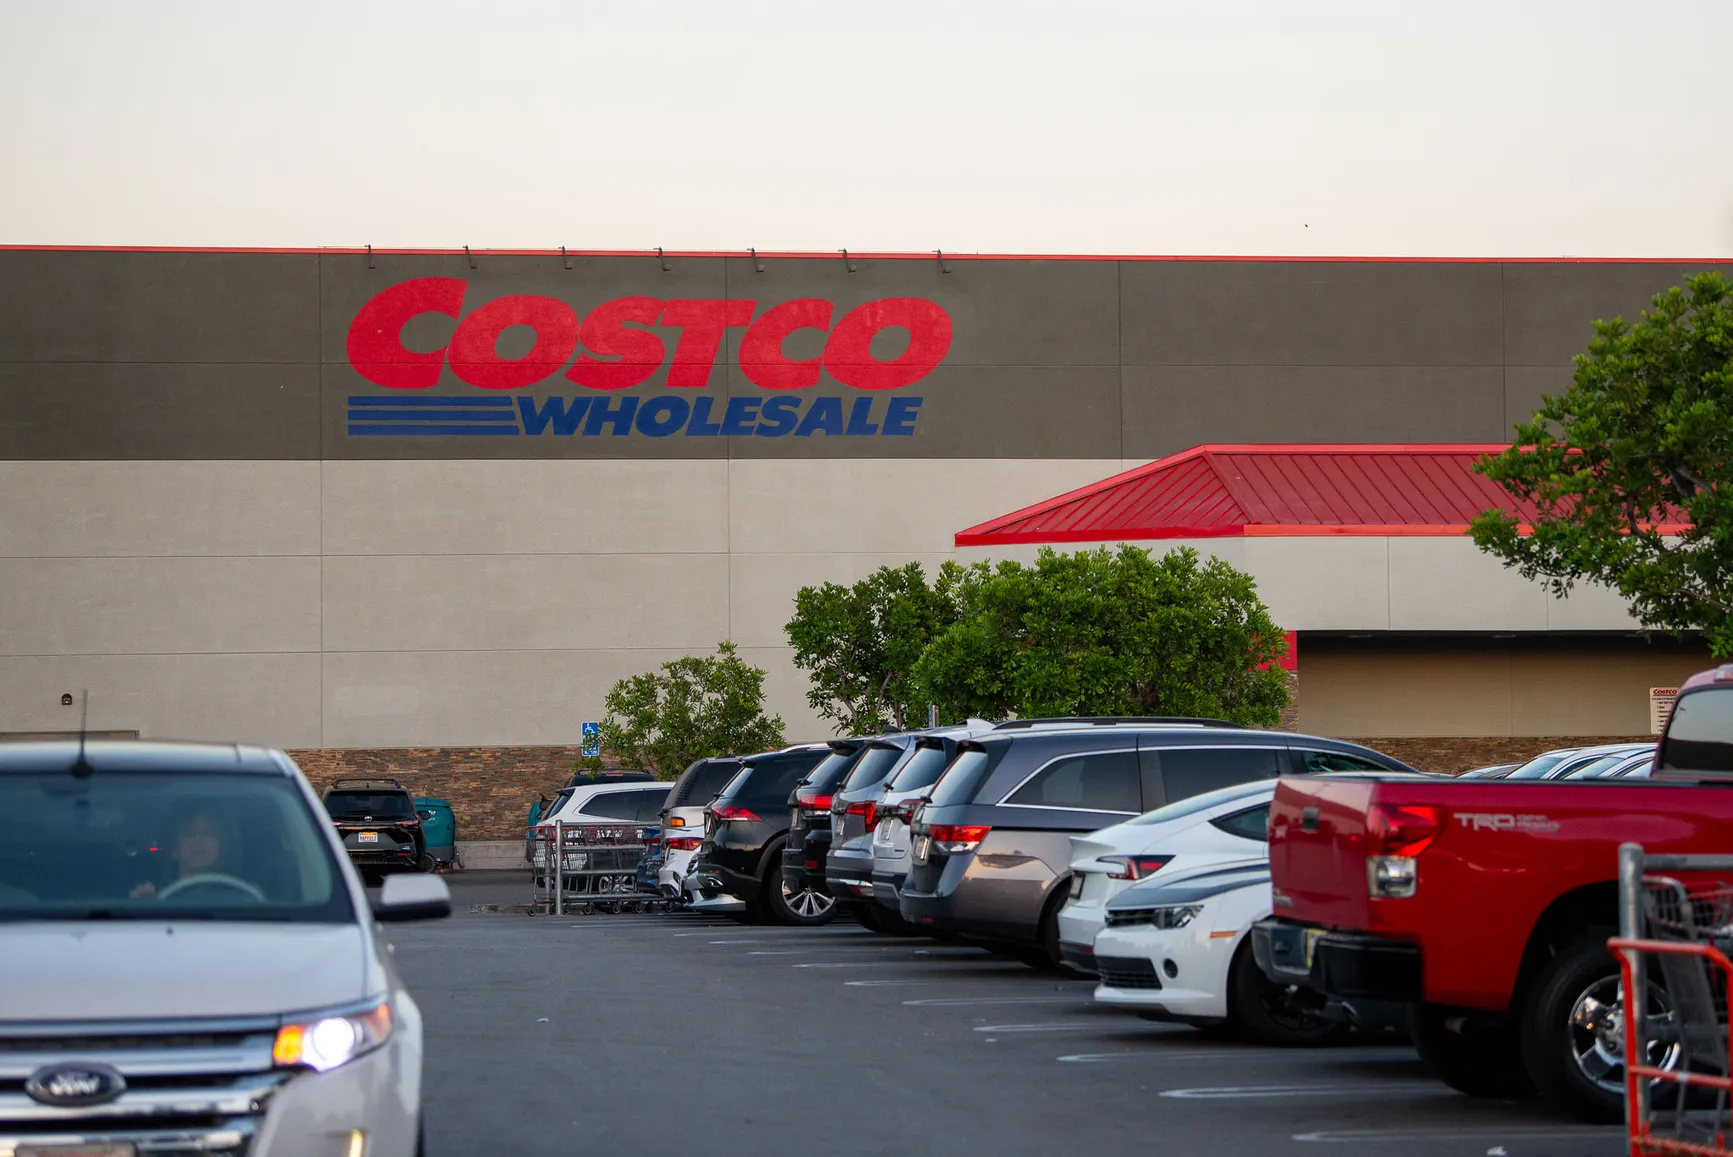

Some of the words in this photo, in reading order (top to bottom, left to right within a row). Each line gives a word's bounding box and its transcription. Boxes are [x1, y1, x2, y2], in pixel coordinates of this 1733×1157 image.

[346, 276, 953, 391] COSTCO
[516, 396, 923, 437] WHOLESALE
[1453, 812, 1516, 832] TRD
